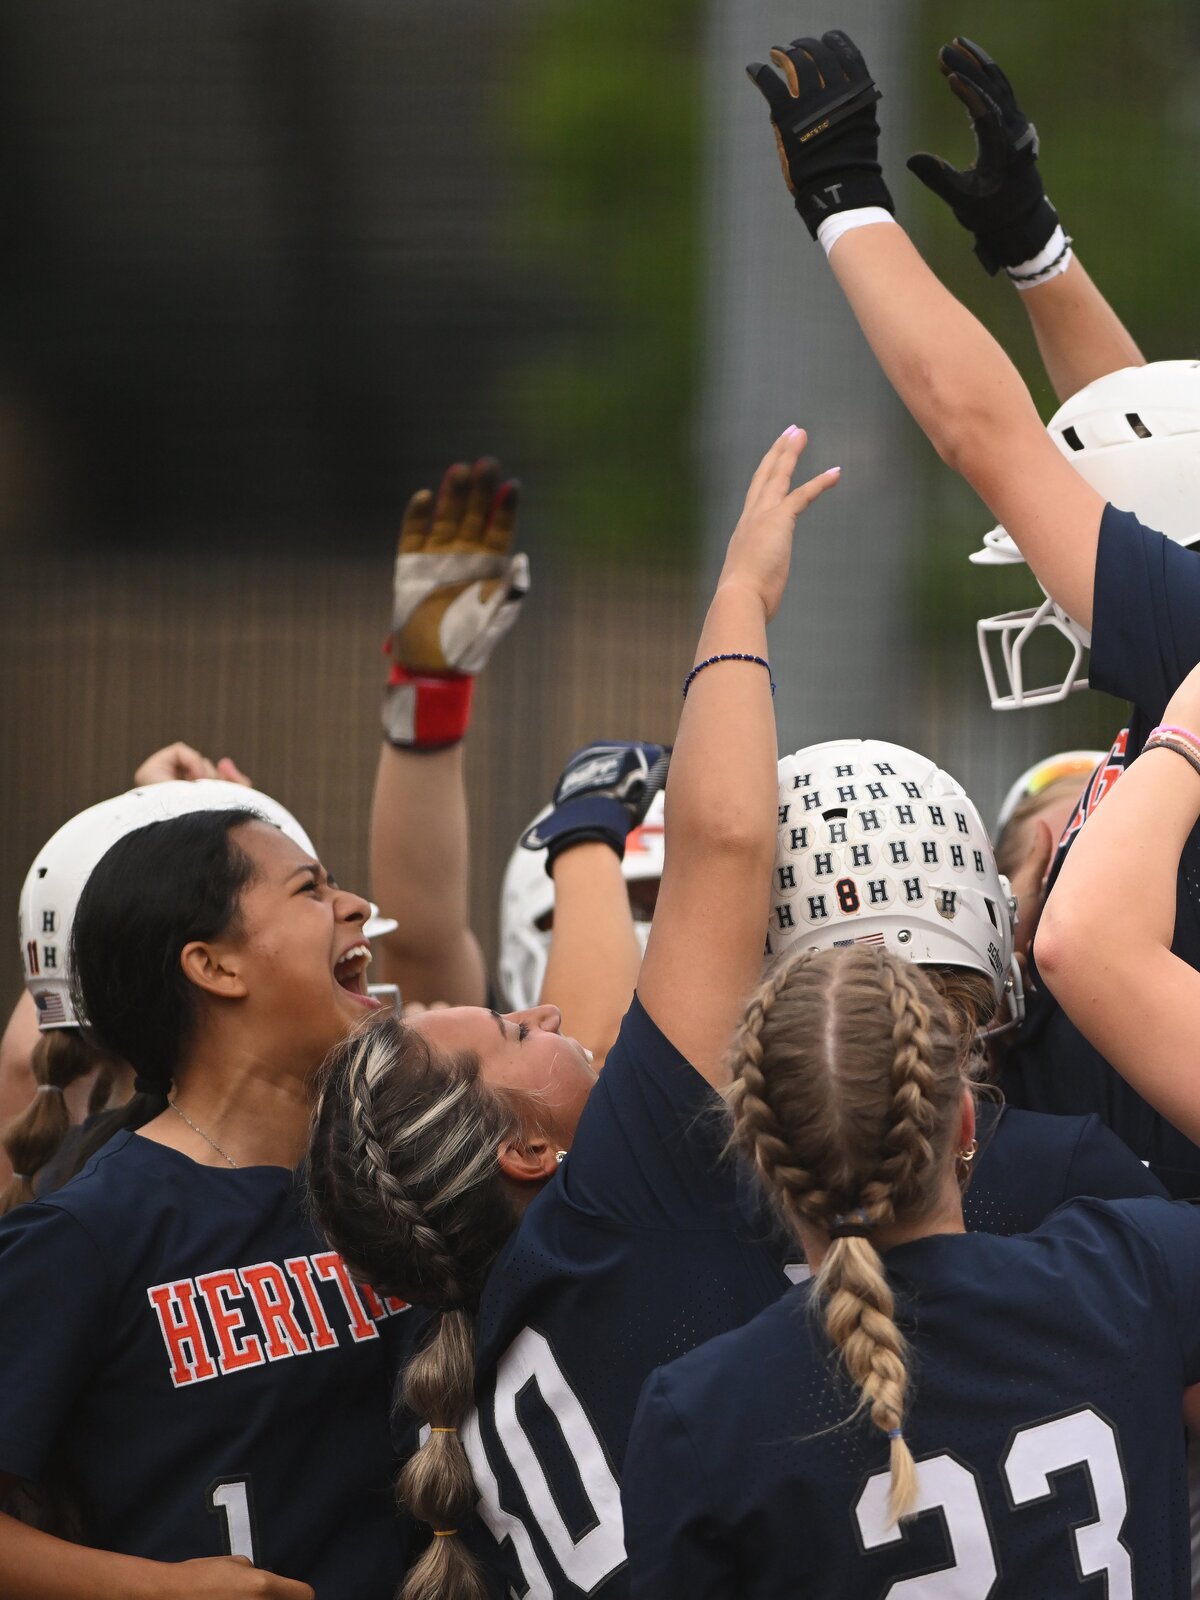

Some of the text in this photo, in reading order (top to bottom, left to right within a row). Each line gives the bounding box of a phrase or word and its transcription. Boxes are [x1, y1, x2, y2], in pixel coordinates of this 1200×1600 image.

[794, 763, 896, 789] H H H
[802, 791, 821, 811] H
[836, 784, 857, 803] H
[865, 782, 888, 799] H
[900, 781, 922, 798] H
[790, 804, 969, 849] H H H H H H
[778, 841, 985, 889] H H H H H H H
[43, 911, 55, 932] H
[776, 876, 957, 929] H H 8 H H H
[44, 947, 56, 968] H
[212, 1481, 254, 1566] 1
[853, 1407, 1135, 1600] 23
